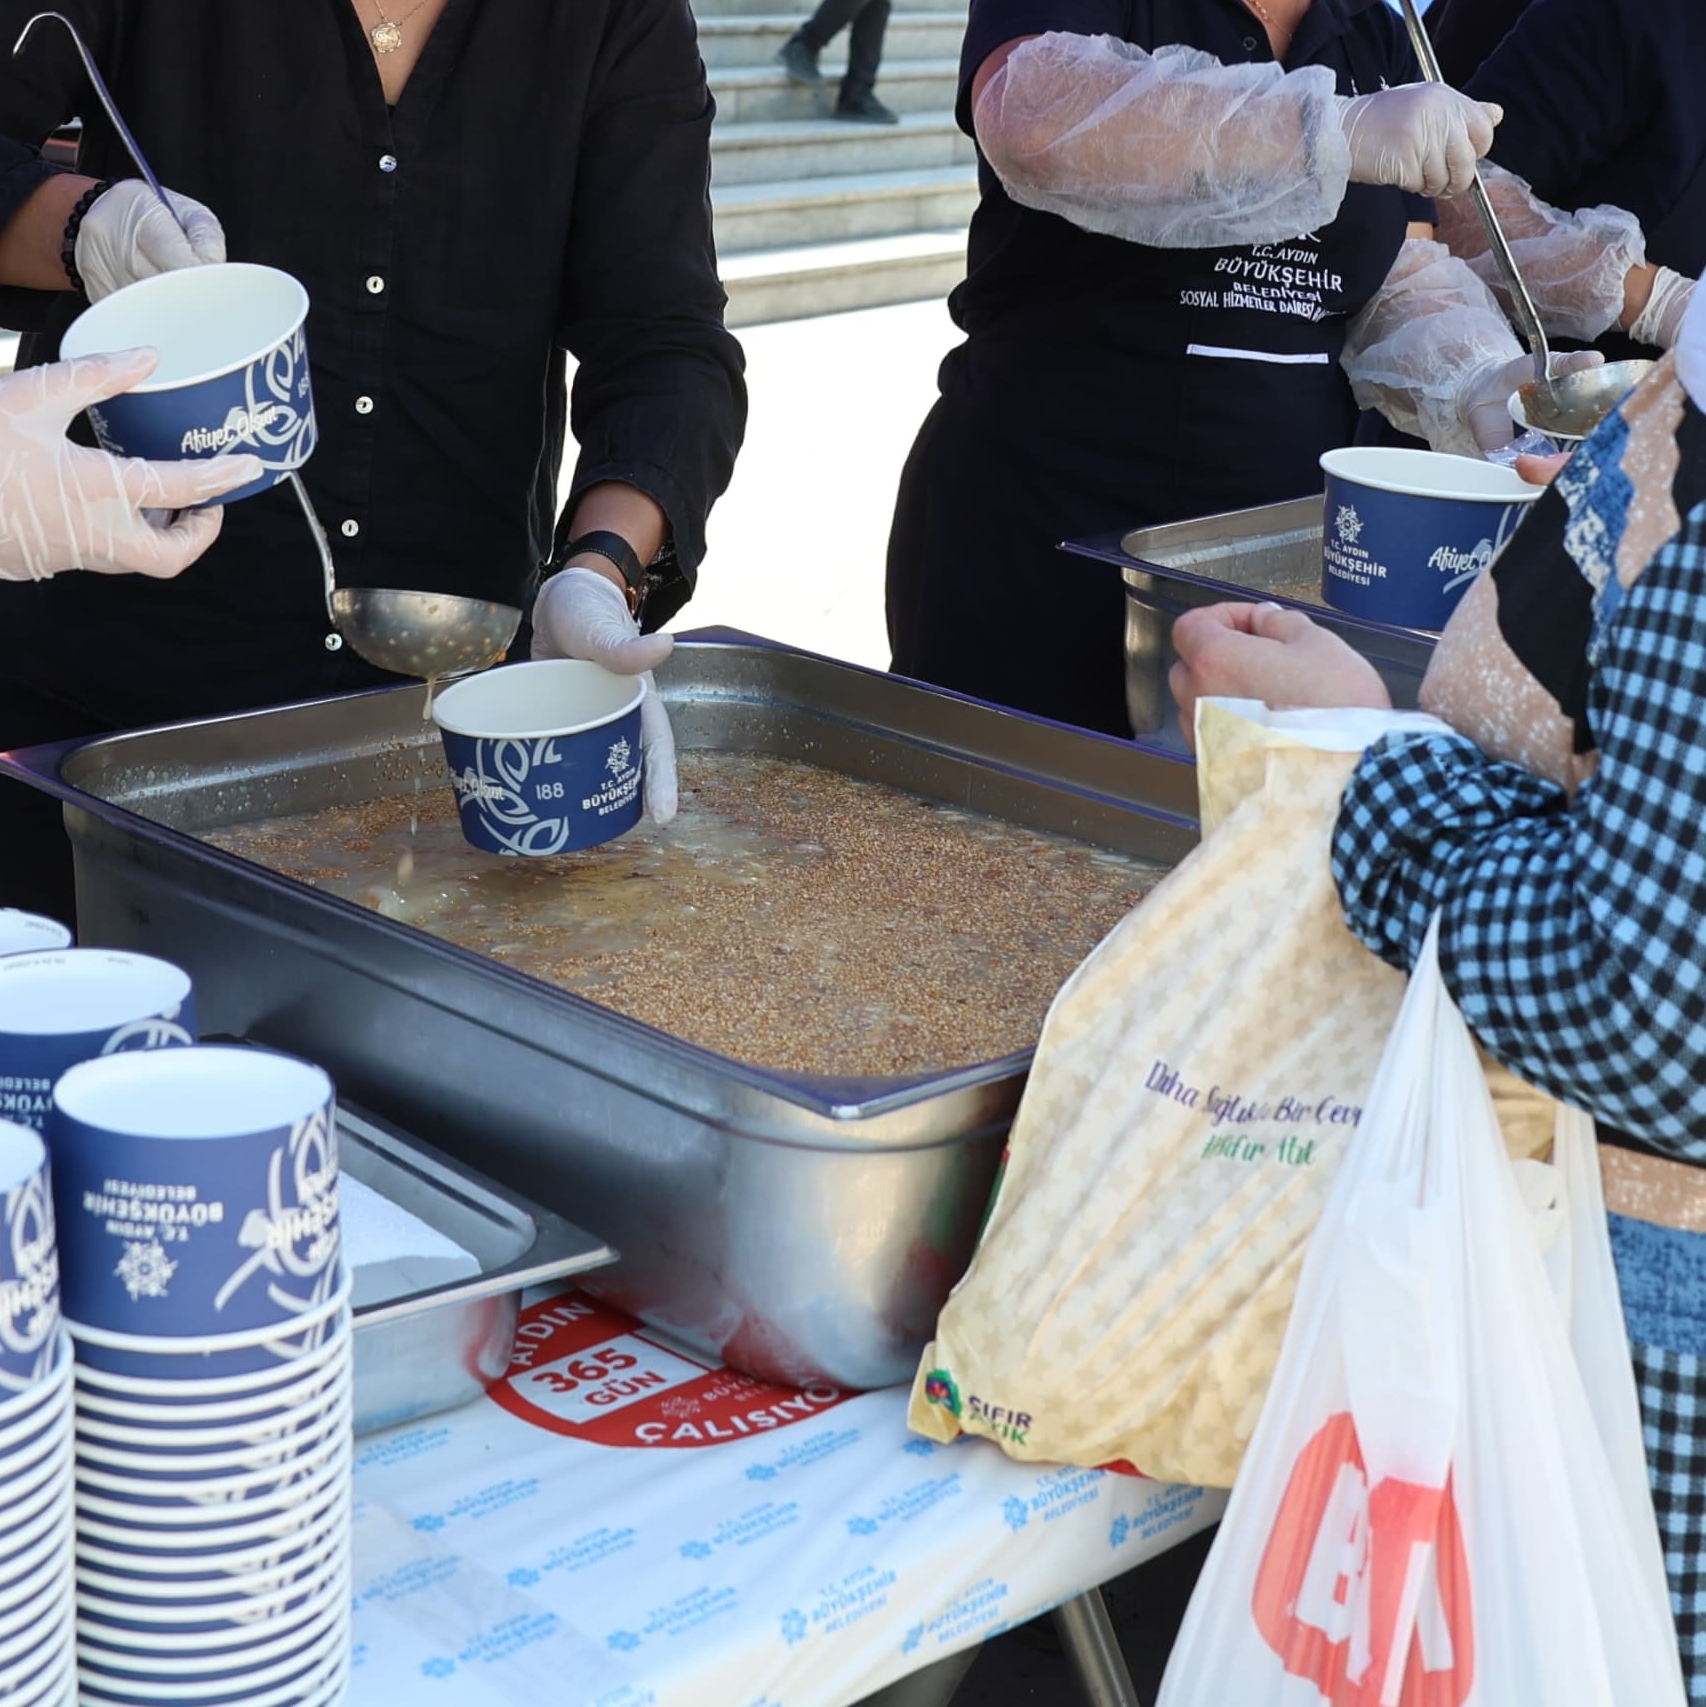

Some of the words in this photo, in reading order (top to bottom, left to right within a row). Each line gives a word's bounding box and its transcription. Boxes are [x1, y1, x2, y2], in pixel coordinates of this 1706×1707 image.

[1274, 246, 1319, 265] AYDIN
[1213, 255, 1343, 292] BÜYÜKŞEHİR
[1180, 289, 1220, 308] SOSYAL
[1223, 291, 1278, 313] HİZMETLER
[1232, 281, 1323, 303] BELEDİYESİ
[180, 425, 236, 454] Afiyet
[1324, 545, 1388, 579] BÜYÜKŞEHİR
[1342, 545, 1369, 559] AYDIN
[1427, 545, 1478, 575] Afiyet
[536, 782, 565, 802] 188
[104, 1178, 197, 1200] BELEDİYESİ
[83, 1191, 224, 1227] BÜYÜKŞEHİR
[105, 1220, 156, 1240] AYDIN
[532, 1347, 638, 1394] 365
[584, 1370, 667, 1407] GÜN
[634, 1385, 840, 1443] ÇALIŞIYO
[968, 1395, 1033, 1429] SIFIR
